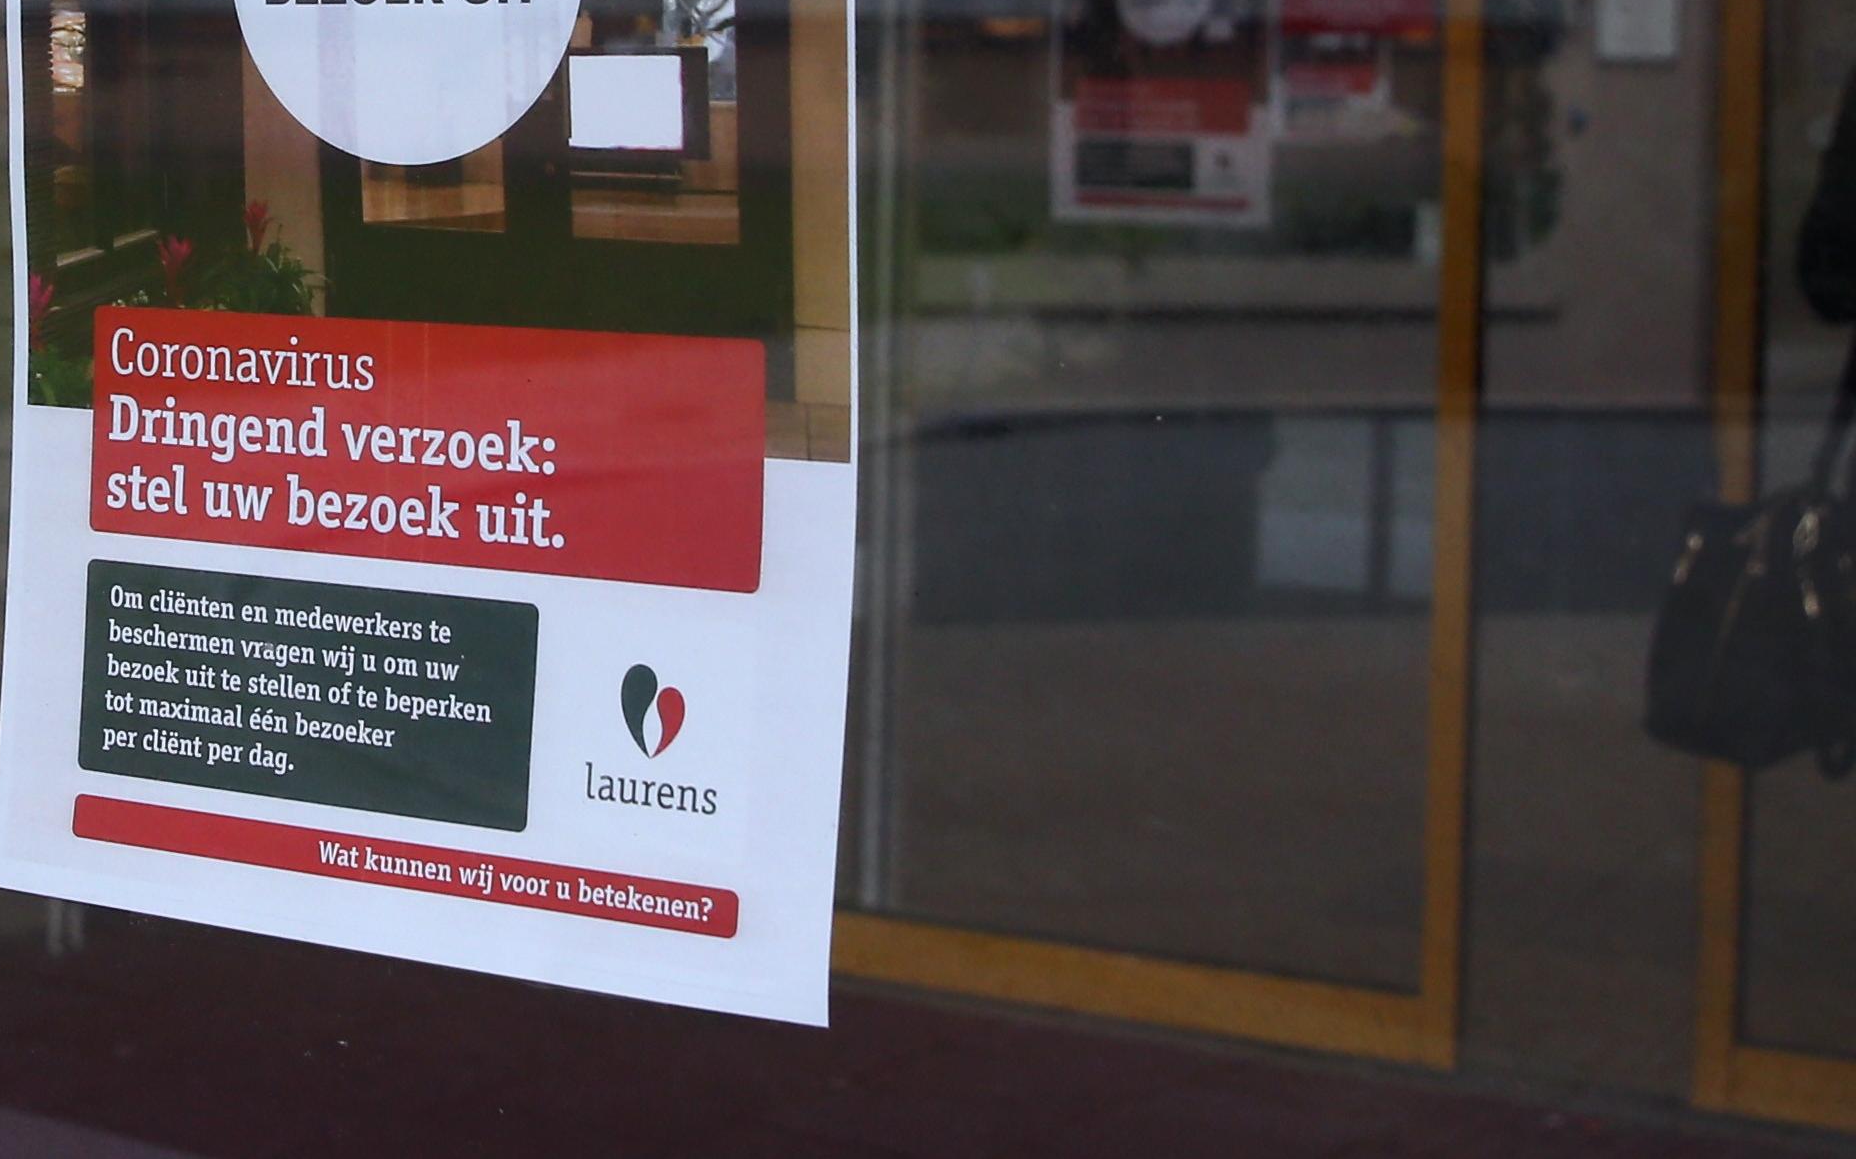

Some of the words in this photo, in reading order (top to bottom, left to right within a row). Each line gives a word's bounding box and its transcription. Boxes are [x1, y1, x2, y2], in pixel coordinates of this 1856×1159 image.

[112, 327, 374, 391] Coronavirus
[108, 394, 327, 461] Dringend
[341, 419, 556, 475] verzoek:
[107, 464, 187, 515] stel
[204, 481, 272, 521] uw
[287, 474, 459, 539] bezoek
[476, 491, 565, 548] uit.
[110, 584, 144, 610] Om
[149, 589, 235, 620] cliënten
[241, 604, 268, 624] en
[275, 606, 423, 641] medewerkers
[429, 619, 452, 644] te
[108, 618, 235, 656] beschermen
[240, 639, 315, 668] vragen
[322, 645, 355, 676] wij
[362, 653, 376, 672] u
[384, 656, 418, 677] om
[425, 661, 459, 682] uw
[105, 689, 134, 713] tot
[138, 698, 243, 728] maximaal
[249, 707, 288, 734] één
[295, 712, 395, 747] bezoeker
[107, 653, 179, 685] bezoek
[185, 664, 216, 689] uit
[220, 669, 241, 692] te
[247, 673, 321, 702] stellen
[328, 681, 352, 705] of
[356, 684, 378, 709] te
[385, 686, 492, 723] beperken
[102, 728, 137, 750] per
[142, 729, 202, 758] cliënt
[206, 742, 243, 765] per
[249, 743, 294, 775] dag.
[586, 762, 718, 815] laurens
[319, 840, 358, 869] Wat
[364, 846, 451, 882] kunnen
[458, 865, 494, 894] wij
[500, 872, 550, 897] voor
[556, 881, 570, 900] u
[577, 878, 714, 923] betekenen?
